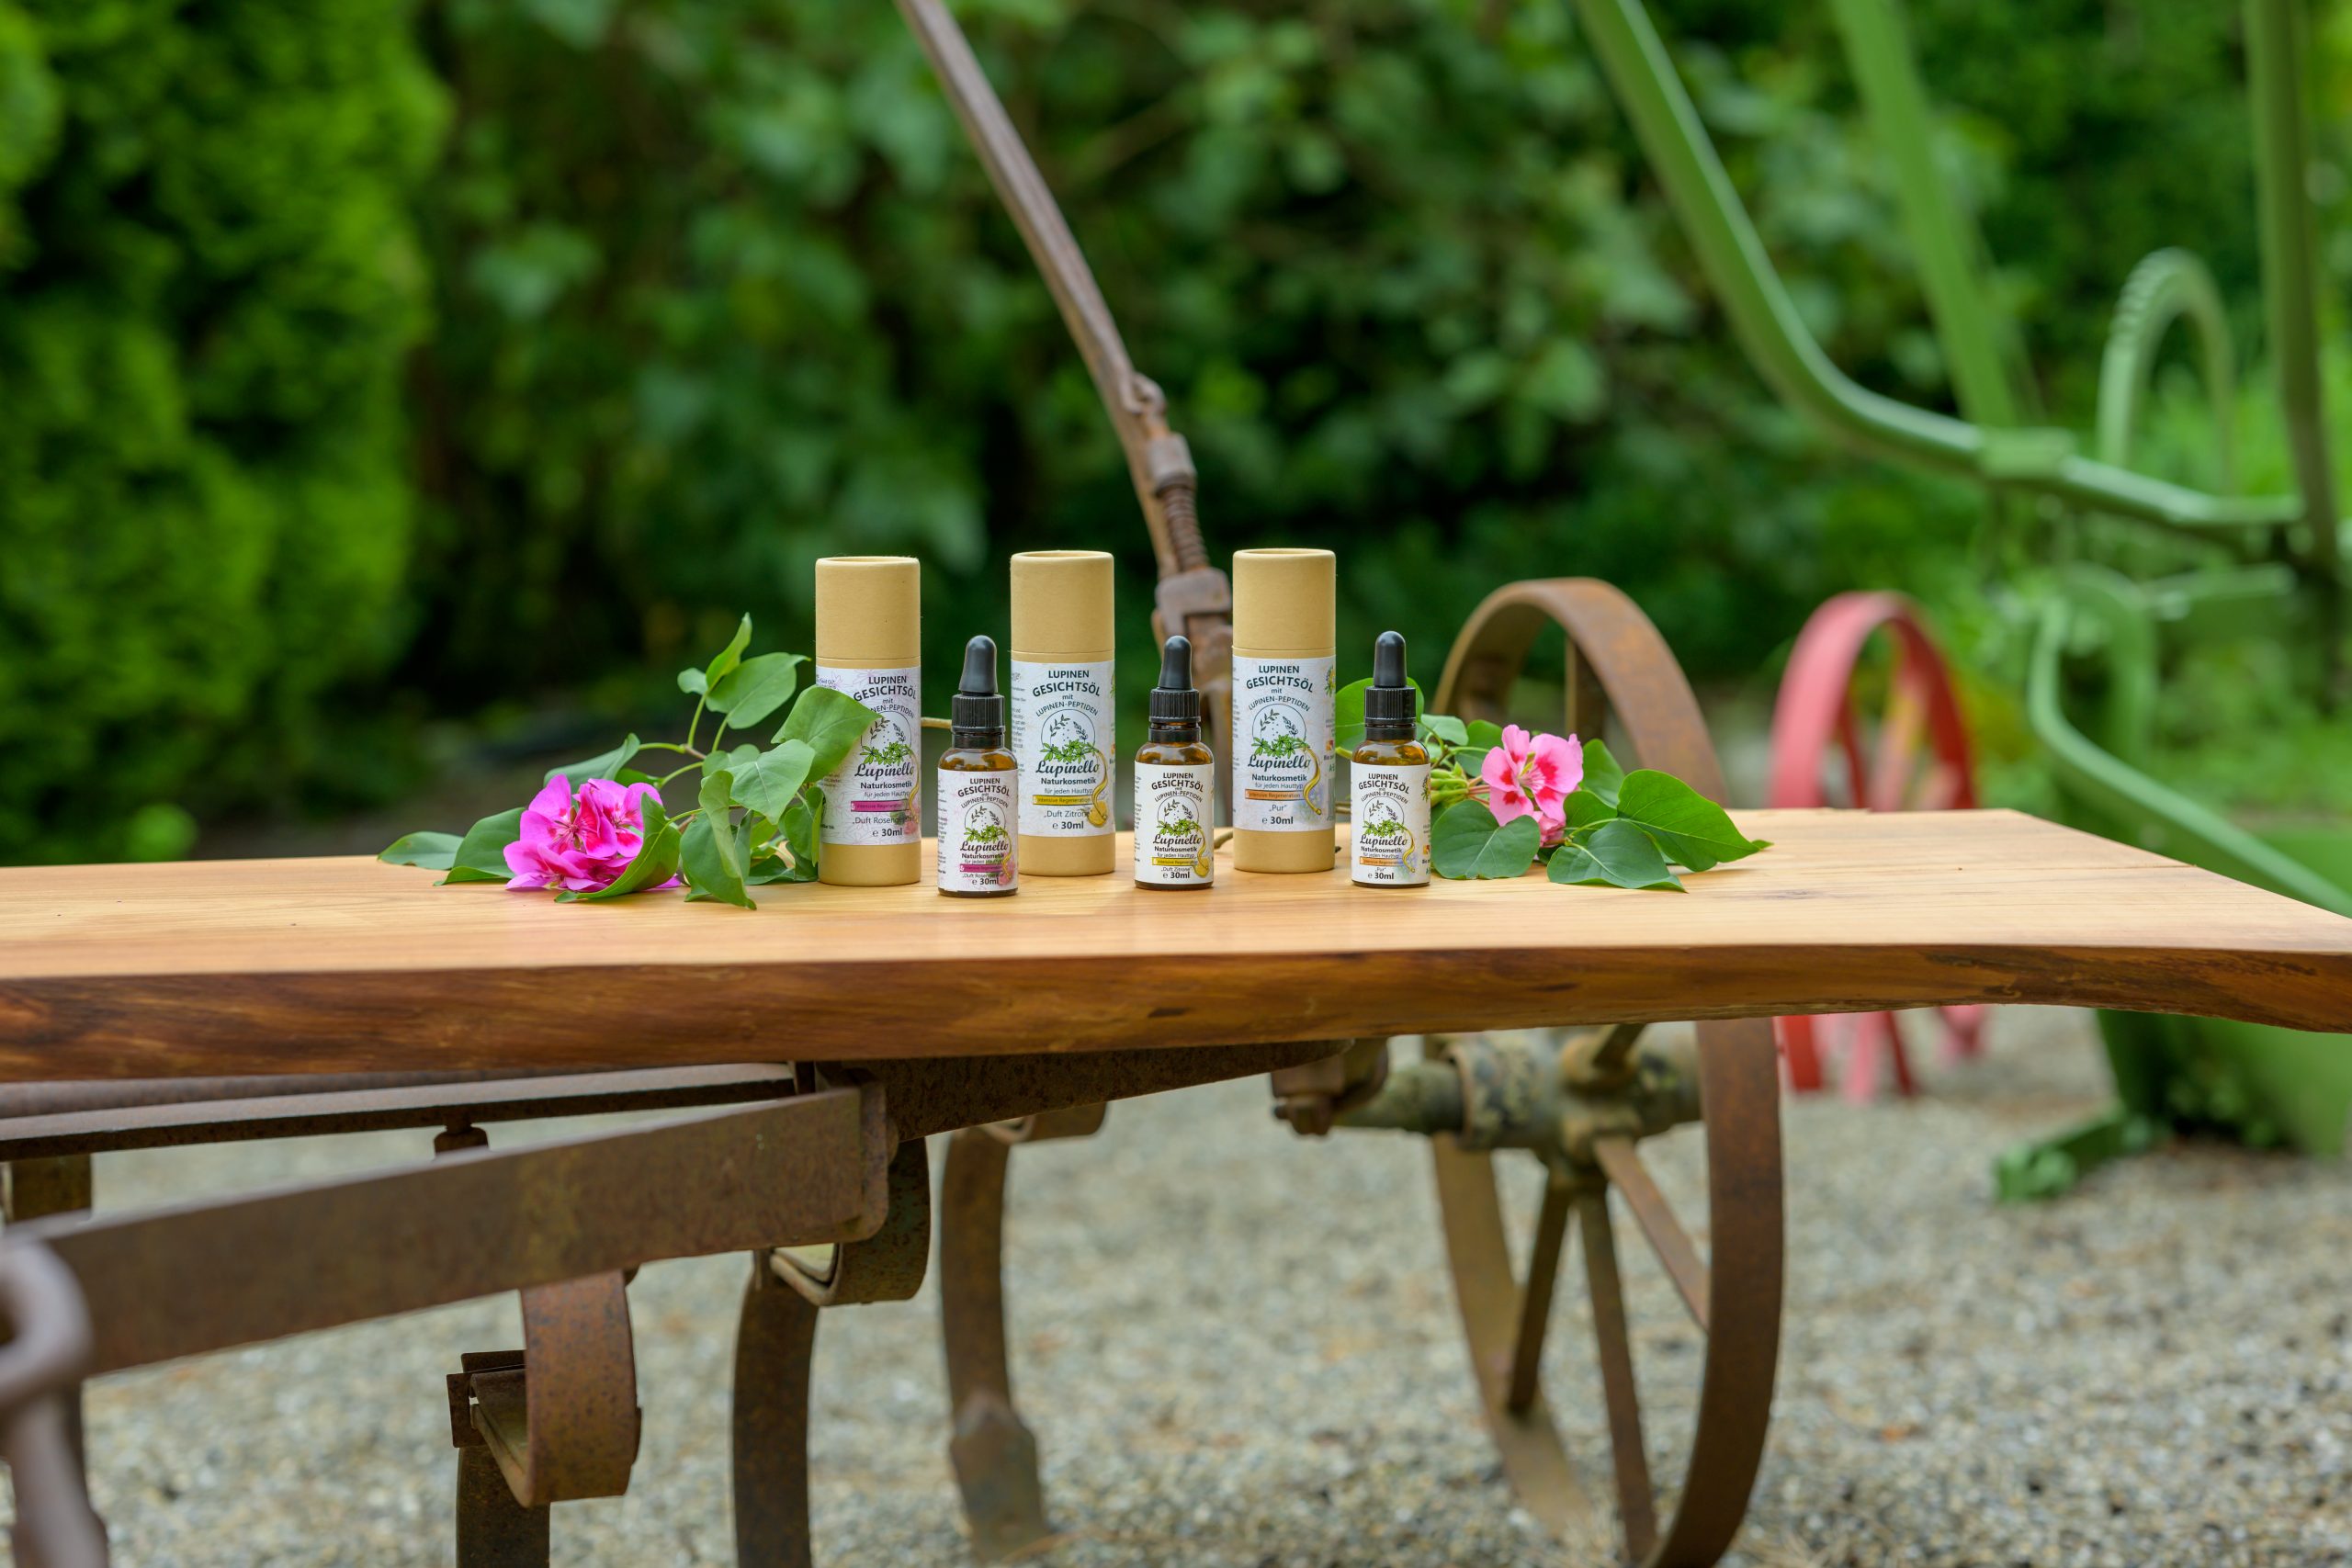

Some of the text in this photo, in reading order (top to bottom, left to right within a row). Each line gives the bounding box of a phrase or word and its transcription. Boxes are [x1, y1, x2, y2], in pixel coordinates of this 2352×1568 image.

[1259, 665, 1299, 673] LUPINEN
[869, 676, 907, 684] LUPINEN
[1247, 676, 1314, 693] GESICHTSÖL
[853, 685, 916, 702] GESICHTSÖL
[1033, 682, 1100, 697] GESICHTSÖL
[1036, 701, 1098, 716] LUPINEN-PEPTIDEN
[1249, 696, 1310, 712] LUPINEN-PEPTIDEN
[1035, 761, 1100, 777] Lupinello
[1248, 754, 1311, 772] Lupinello
[854, 762, 914, 781] Lupinello
[1252, 773, 1306, 782] Naturkosmetik
[860, 781, 912, 789] Naturkosmetik
[958, 785, 1010, 797] GESICHTSÖL
[1152, 780, 1204, 792] GESICHTSÖL
[1359, 780, 1409, 794] GESICHTSÖL
[1155, 791, 1202, 803] LUPINEN-PEPTIDEN
[1362, 792, 1408, 805] LUPINEN-PEPTIDEN
[1061, 821, 1084, 829] 30ml
[882, 828, 902, 836] 30ml
[960, 840, 1009, 854] Lupinello
[1153, 834, 1202, 847] Lupinello
[1360, 834, 1408, 848] Lupinello
